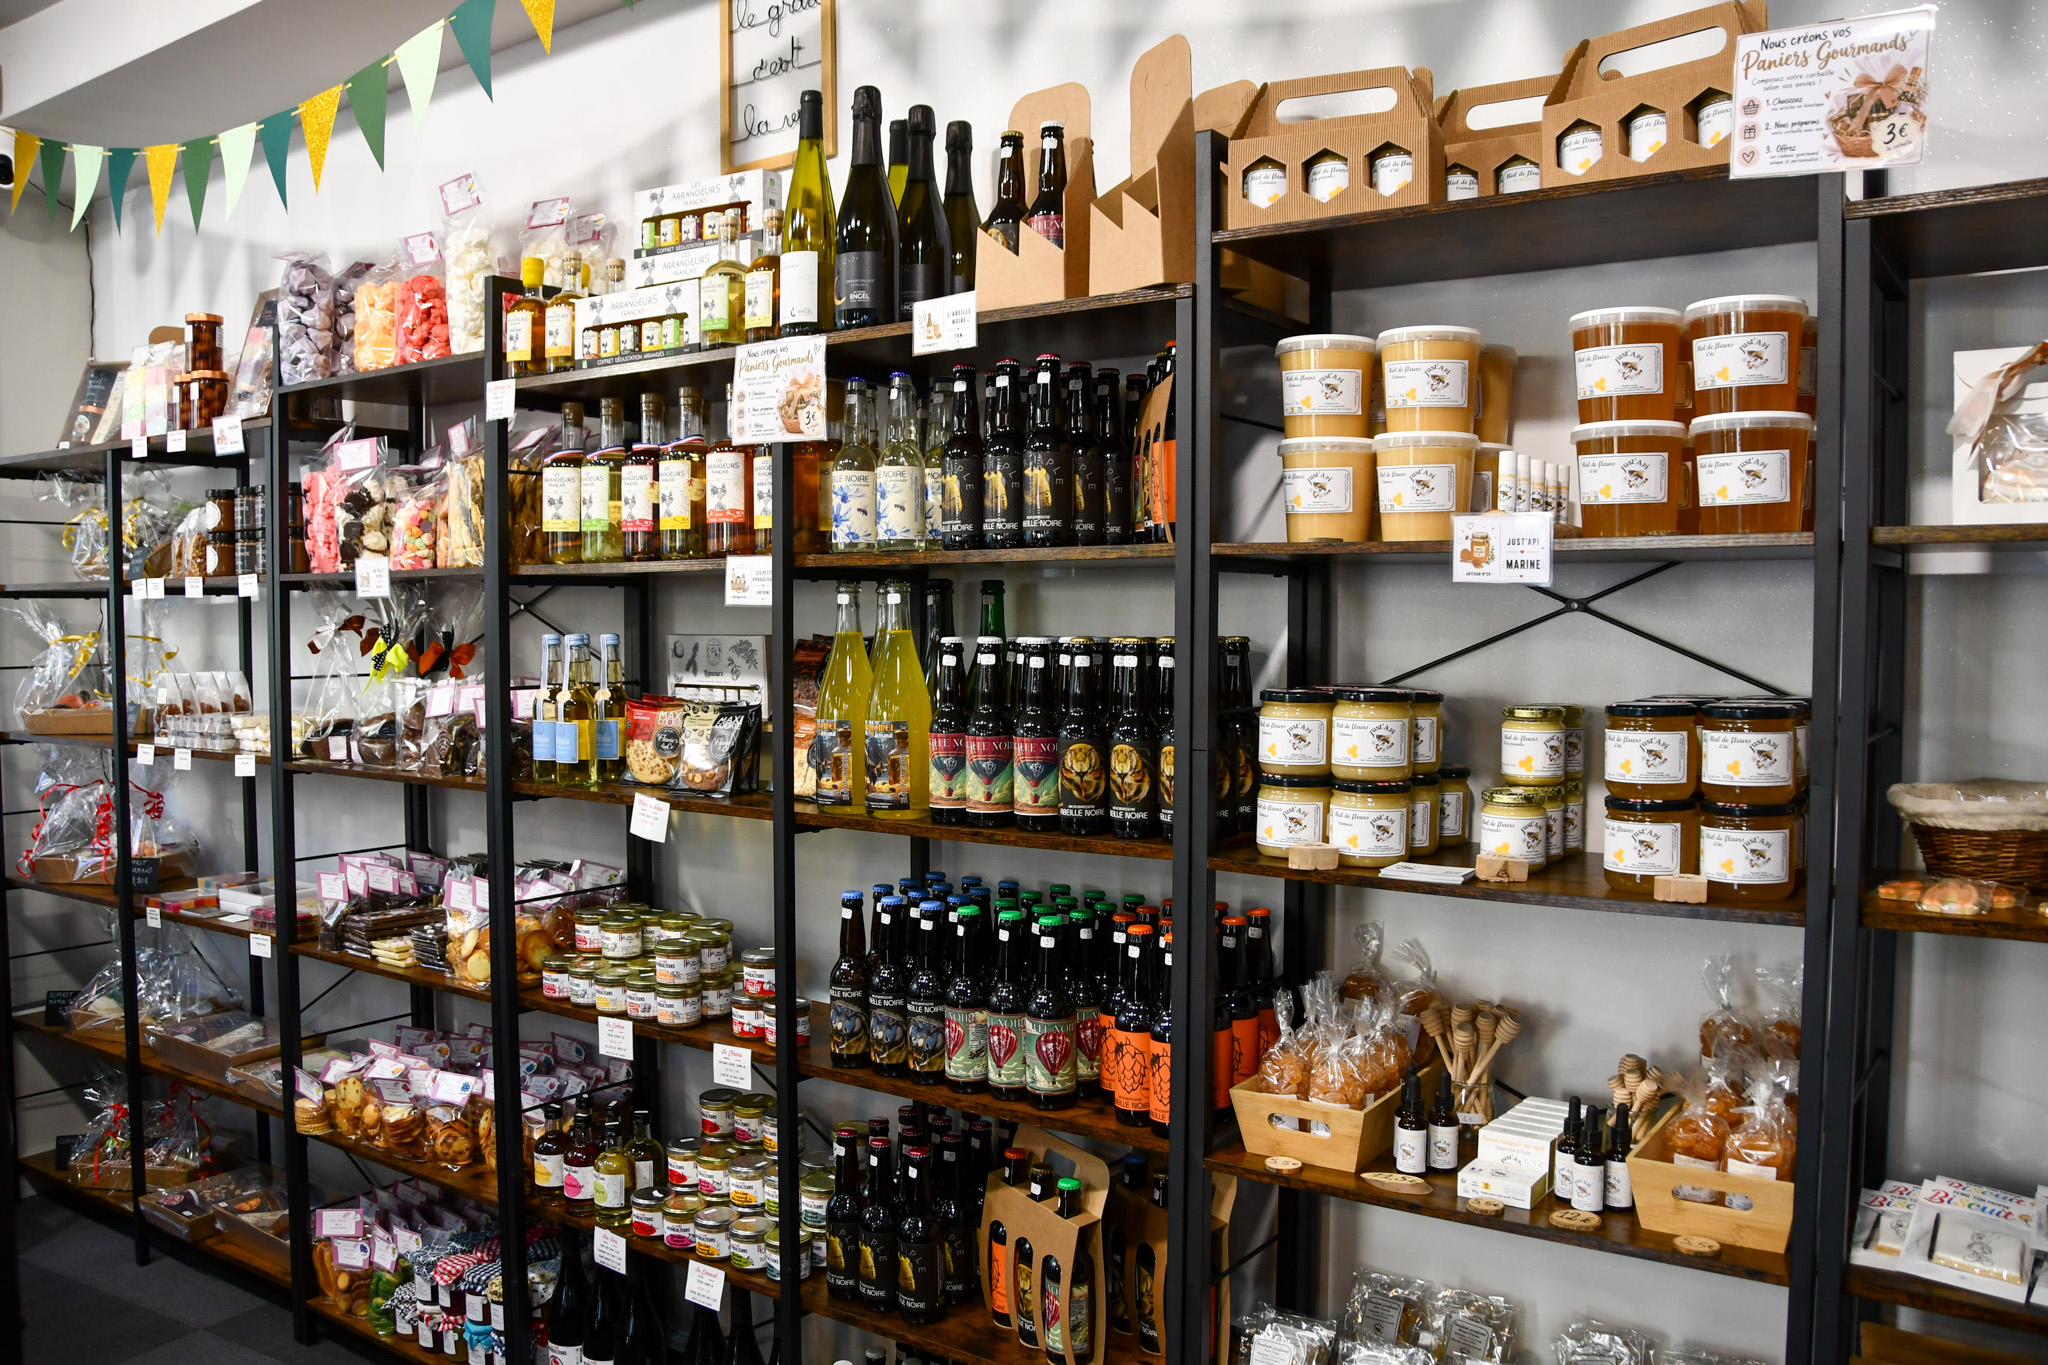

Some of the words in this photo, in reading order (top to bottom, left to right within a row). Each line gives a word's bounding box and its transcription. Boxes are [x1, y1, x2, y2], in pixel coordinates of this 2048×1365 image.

[1761, 34, 1788, 51] Nous
[1790, 30, 1828, 47] créons
[1832, 26, 1852, 38] vos
[1742, 49, 1812, 80] Paniers
[1816, 34, 1910, 70] Gourmands
[1752, 76, 1785, 86] Composez
[1786, 73, 1804, 82] votre
[1806, 70, 1835, 79] corbeille
[1764, 83, 1780, 92] selon
[1795, 80, 1816, 88] envies
[1773, 97, 1803, 106] Choisissez
[1791, 120, 1820, 129] préparons
[1883, 123, 1896, 145] 3
[1899, 123, 1909, 138] €
[1776, 144, 1796, 153] Offrez
[672, 184, 721, 200] ARRANGEURS
[683, 198, 708, 206] FRANÇAIS
[675, 242, 704, 252] DÉGUSTATION
[662, 254, 710, 270] ARRANGEURS
[673, 268, 697, 276] FRANÇAIS
[610, 295, 658, 311] ARRANGEURS
[621, 308, 646, 318] FRANÇAIS
[948, 308, 971, 318] L'ABEILLE
[952, 317, 966, 325] NOIRE
[747, 350, 760, 359] Nous
[761, 347, 778, 356] créons
[780, 345, 789, 353] vos
[597, 358, 614, 366] COFFRET
[615, 354, 641, 364] DÉGUSTATION
[738, 358, 770, 378] Paniers
[772, 350, 814, 374] Gourmands
[805, 411, 812, 426] 3
[812, 412, 817, 422] €
[845, 475, 870, 483] NOIRE
[883, 470, 906, 478] NOIRE
[996, 522, 1019, 530] NOIRE
[1507, 538, 1540, 546] JUST'API
[1506, 560, 1541, 570] MARINE
[718, 716, 744, 724] MAXI
[1085, 808, 1105, 817] NOIRE
[1125, 810, 1148, 820] NOIRE
[842, 990, 863, 998] NOIRE
[883, 999, 904, 1007] NOIRE
[923, 1004, 945, 1014] NOIRE
[1482, 1136, 1498, 1144] Savon
[1946, 1180, 2026, 1206] Biscuit
[1924, 1188, 2016, 1221] Biscuit
[1556, 1211, 1581, 1220] 12
[835, 1279, 856, 1287] NOIRE
[866, 1288, 886, 1297] NOIRE
[906, 1300, 926, 1309] NOIRE
